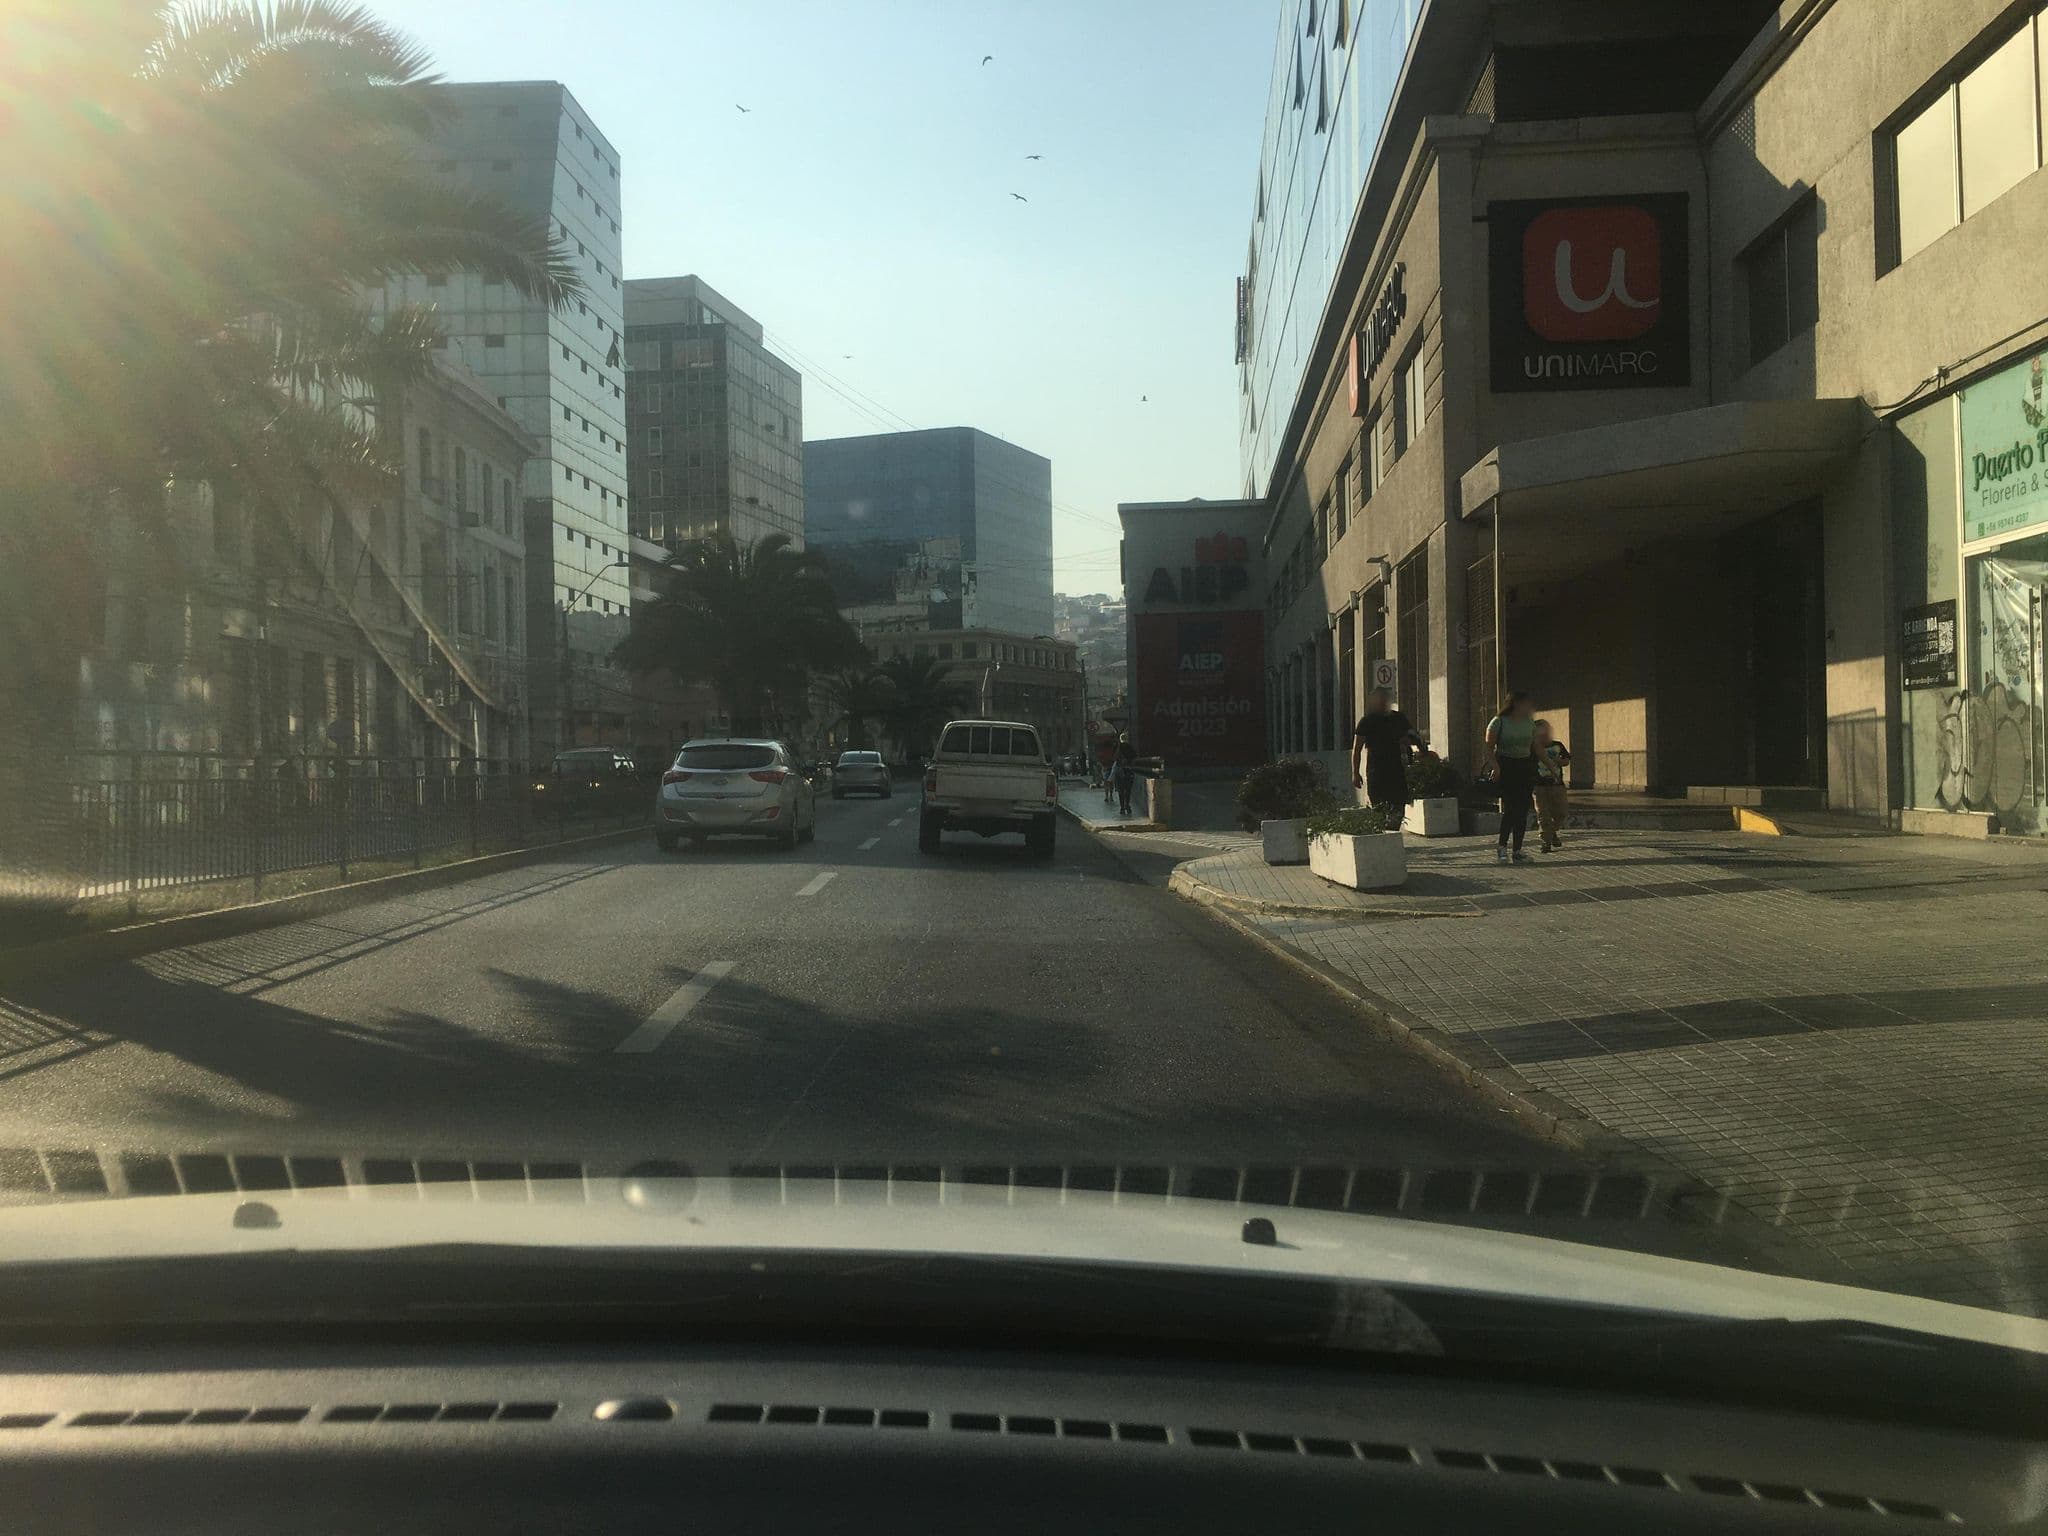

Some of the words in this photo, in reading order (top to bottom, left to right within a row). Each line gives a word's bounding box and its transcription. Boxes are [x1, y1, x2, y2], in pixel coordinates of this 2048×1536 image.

[1972, 440, 2034, 492] Puerto
[2031, 472, 2040, 492] &
[1144, 566, 1249, 604] AIEP
[1179, 653, 1223, 672] AIEP
[1153, 695, 1251, 717] Admisión
[1177, 718, 1227, 737] 2023
